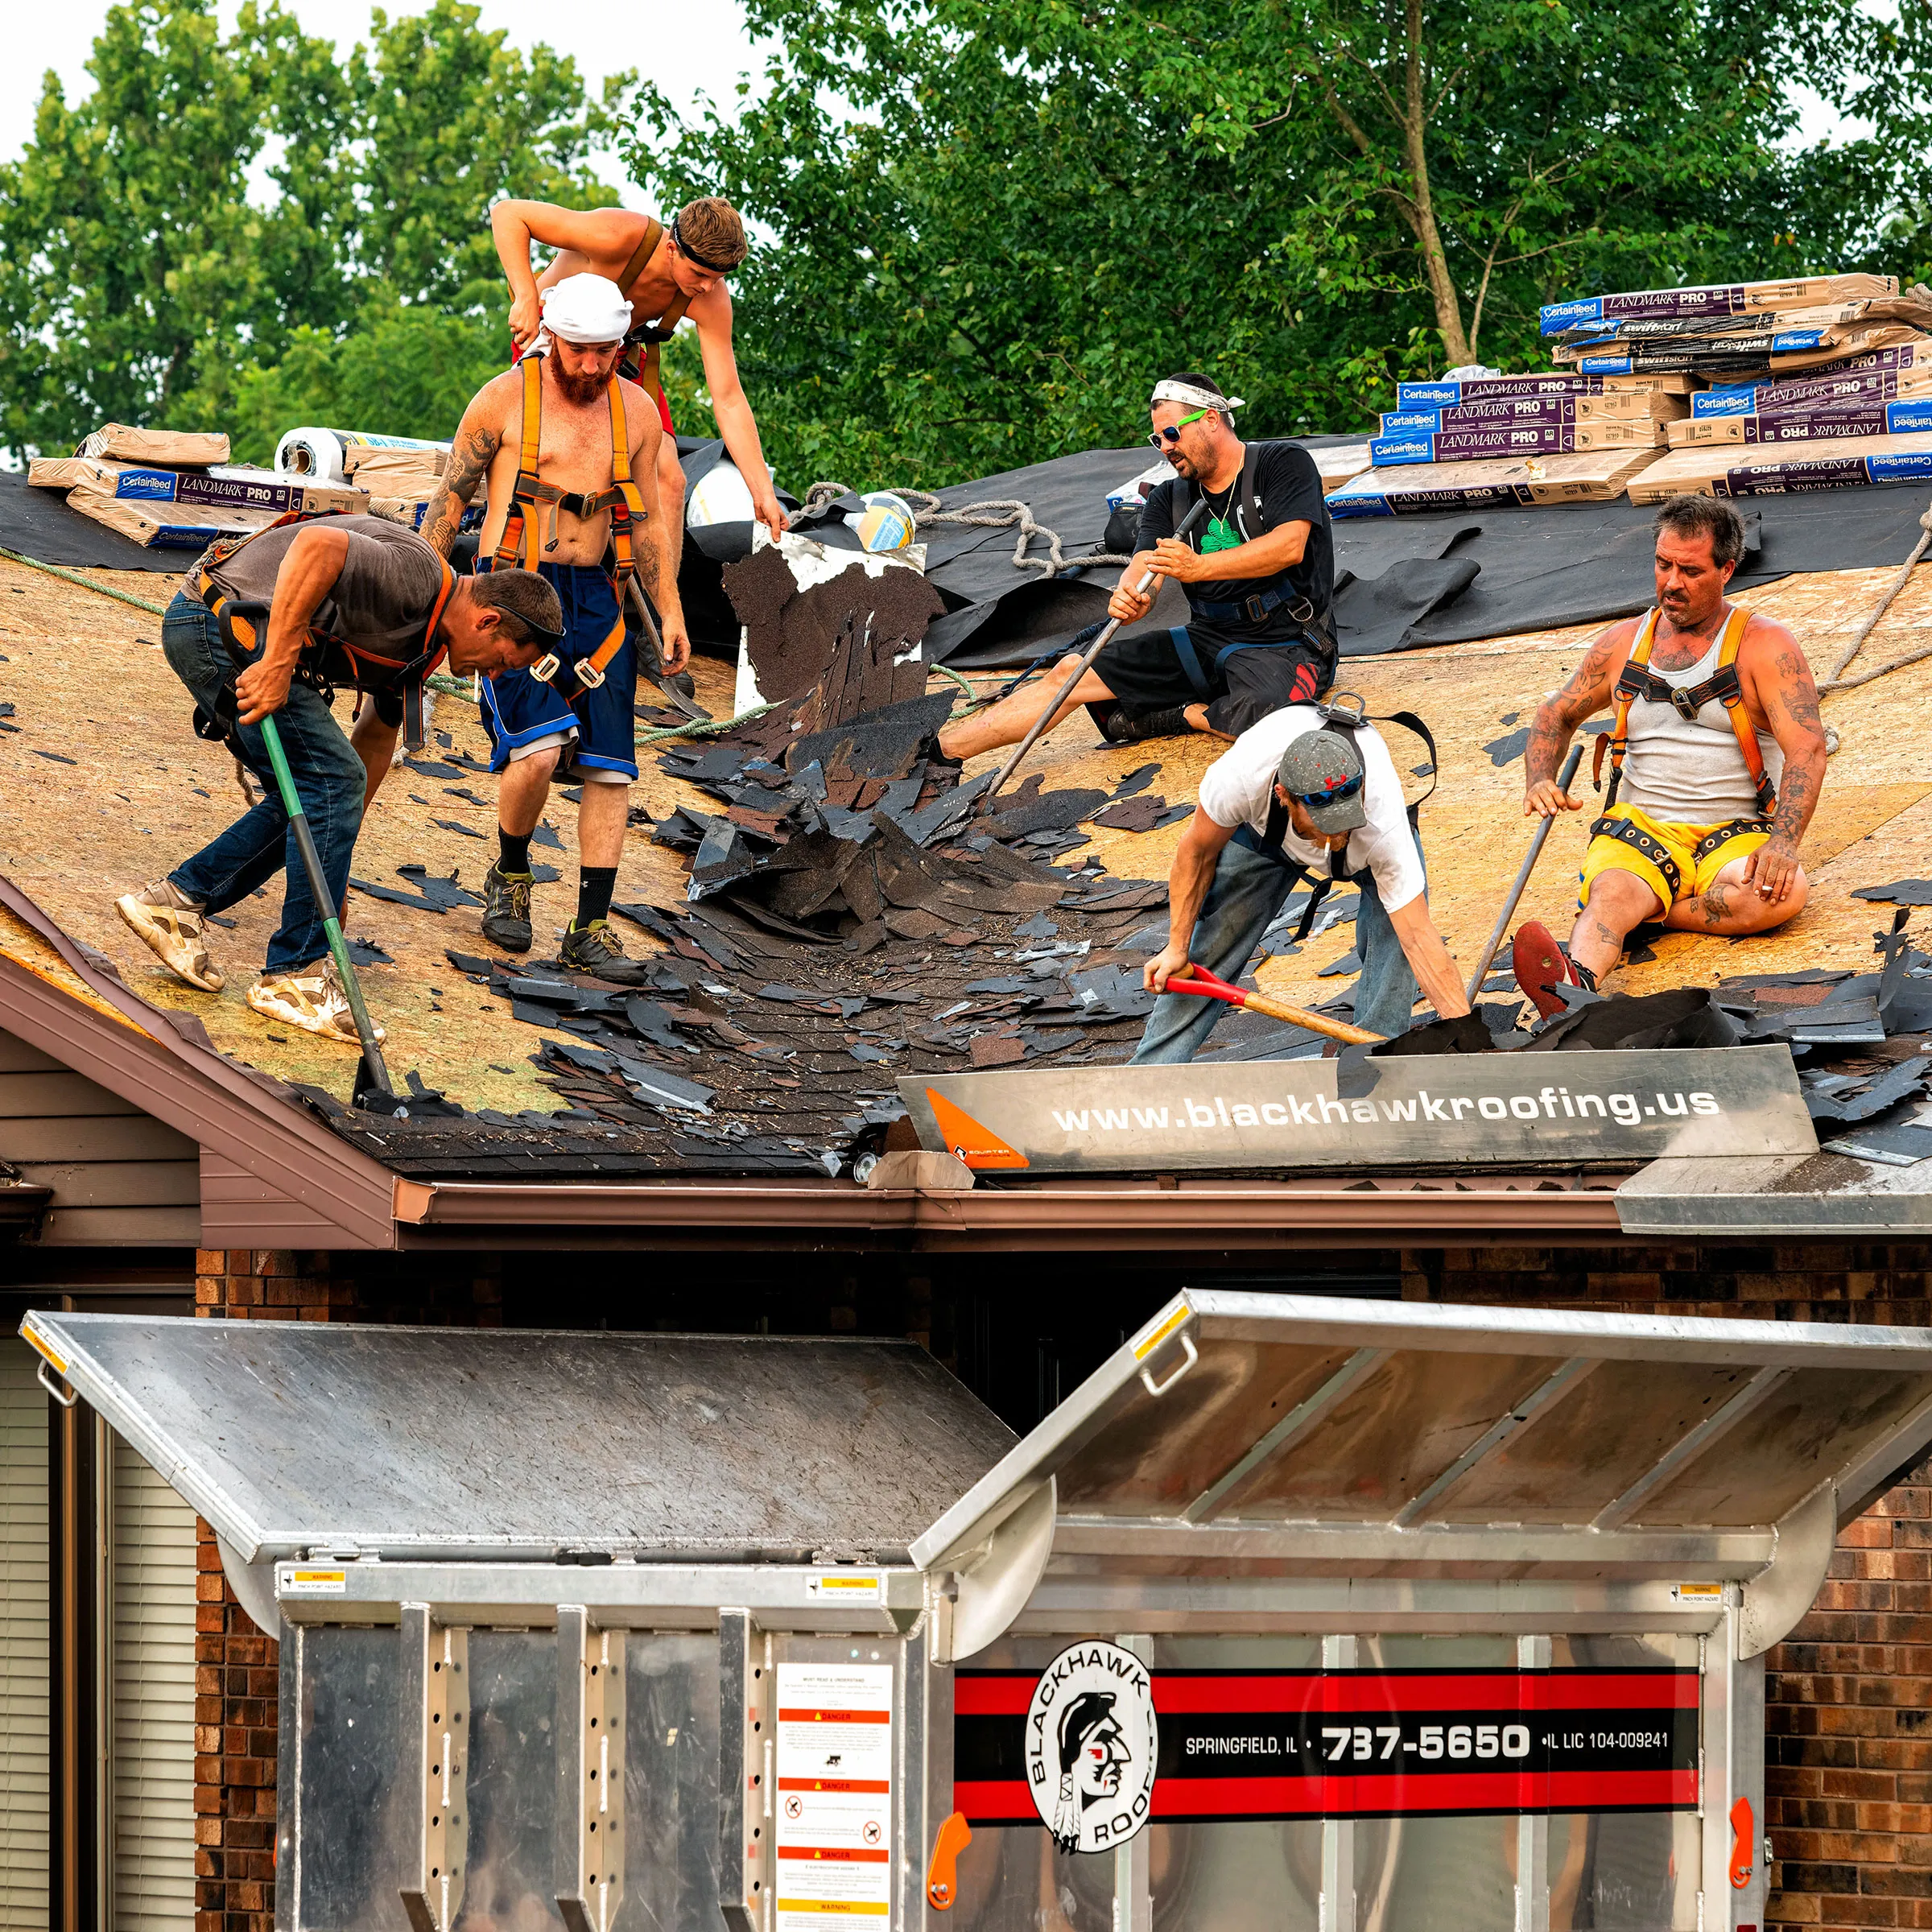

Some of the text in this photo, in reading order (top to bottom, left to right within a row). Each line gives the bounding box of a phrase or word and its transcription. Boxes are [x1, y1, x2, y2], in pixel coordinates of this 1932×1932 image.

[1609, 292, 1707, 308] LANDMARK PRO
[1544, 303, 1597, 317] CertainTeed
[1623, 321, 1683, 332] swiftstart
[1850, 354, 1877, 369] PRO
[1403, 389, 1455, 399] CertainTeed
[1467, 381, 1567, 395] LANDMARK PRO
[1761, 381, 1861, 402] LANDMARK PRO
[1447, 400, 1541, 419] LANDMARK PRO
[1697, 396, 1749, 409] CertainTeed
[1386, 413, 1435, 427] CertainTeed
[1893, 417, 1932, 428] tainTeed
[1781, 423, 1881, 439] LANDMARK PRO
[1439, 430, 1538, 448] LANDMARK PRO
[1375, 442, 1428, 455] CertainTeed
[1750, 458, 1859, 474] LANDMARK PRO
[1872, 456, 1932, 467] CertainTeed
[122, 477, 171, 489] CertainTeed
[182, 477, 242, 497] LANDMARK
[246, 486, 272, 501] PRO
[1393, 488, 1493, 502] LANDMARK PRO
[1327, 497, 1382, 509] CertainTeed
[158, 531, 210, 543] CertainTeed
[1051, 1087, 1720, 1132] www.blackhawkroofing.us
[821, 1712, 851, 1720] DANGER
[1030, 1649, 1150, 1785] BLACKHAWK
[1186, 1736, 1282, 1756] SPRINGFIELD,
[1286, 1736, 1298, 1753] IL
[1321, 1724, 1530, 1761] 737-5650
[1563, 1732, 1584, 1749] LIC
[1589, 1732, 1668, 1748] 104-009241
[821, 1781, 851, 1790] DANGER
[821, 1851, 851, 1859] DANGER
[820, 1904, 852, 1912] WARNING
